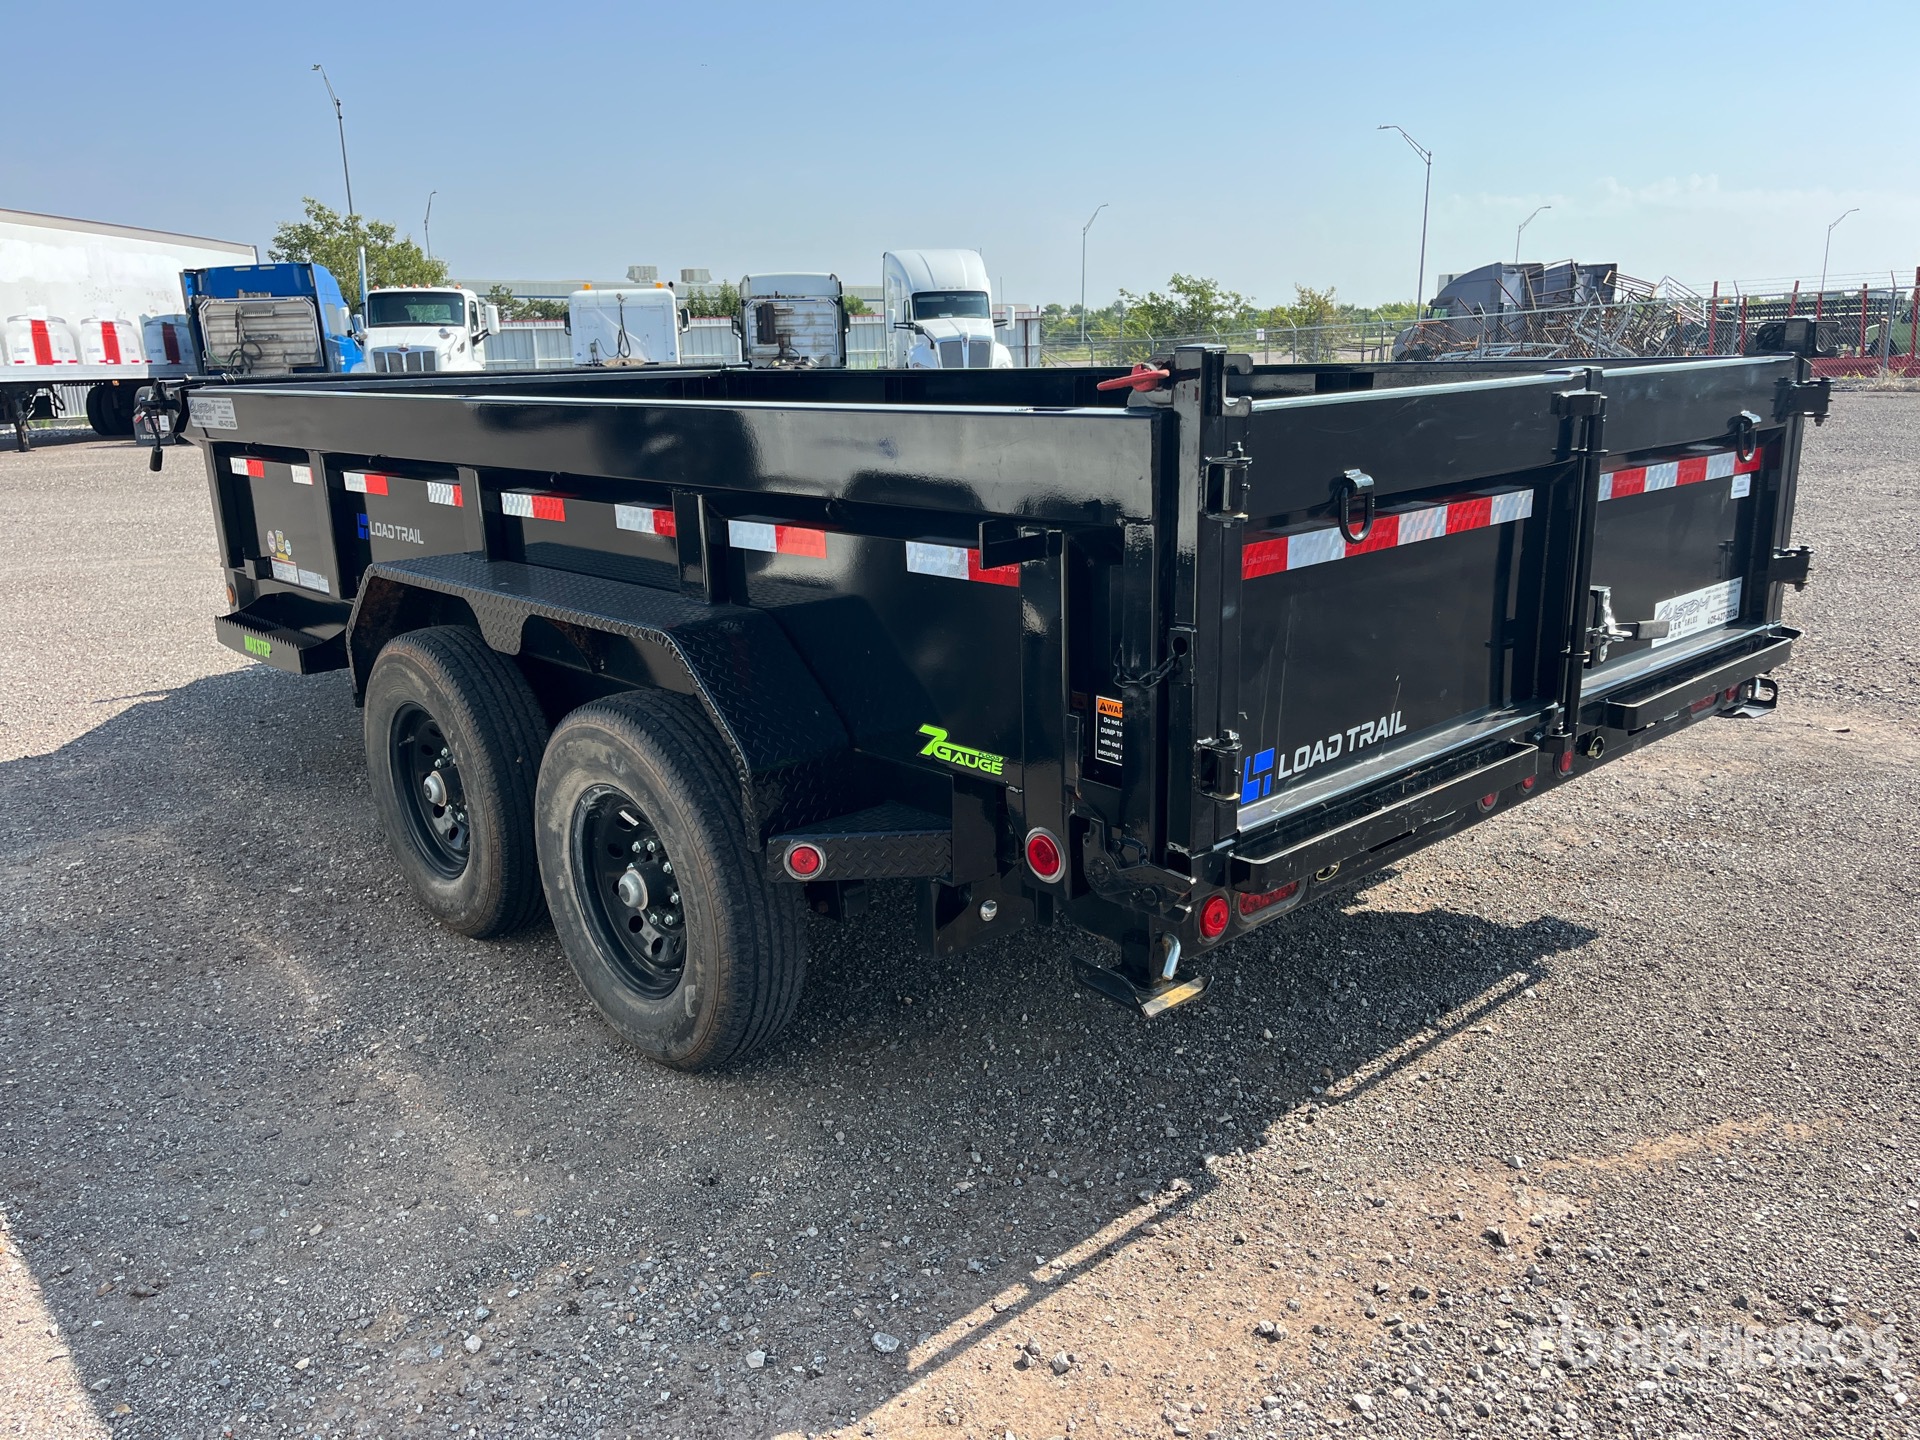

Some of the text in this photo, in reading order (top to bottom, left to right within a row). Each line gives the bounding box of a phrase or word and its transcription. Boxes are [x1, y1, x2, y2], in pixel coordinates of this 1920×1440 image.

[370, 521, 395, 539] LOAD
[395, 525, 424, 545] TRAIL
[1103, 716, 1120, 727] Do not
[918, 724, 948, 756] 7
[1100, 726, 1116, 736] DUMP
[1100, 738, 1120, 749] with out
[1278, 733, 1343, 780] LOAD
[1346, 710, 1407, 753] TRAIL
[932, 740, 1004, 776] GAUGE
[1098, 749, 1119, 761] securing
